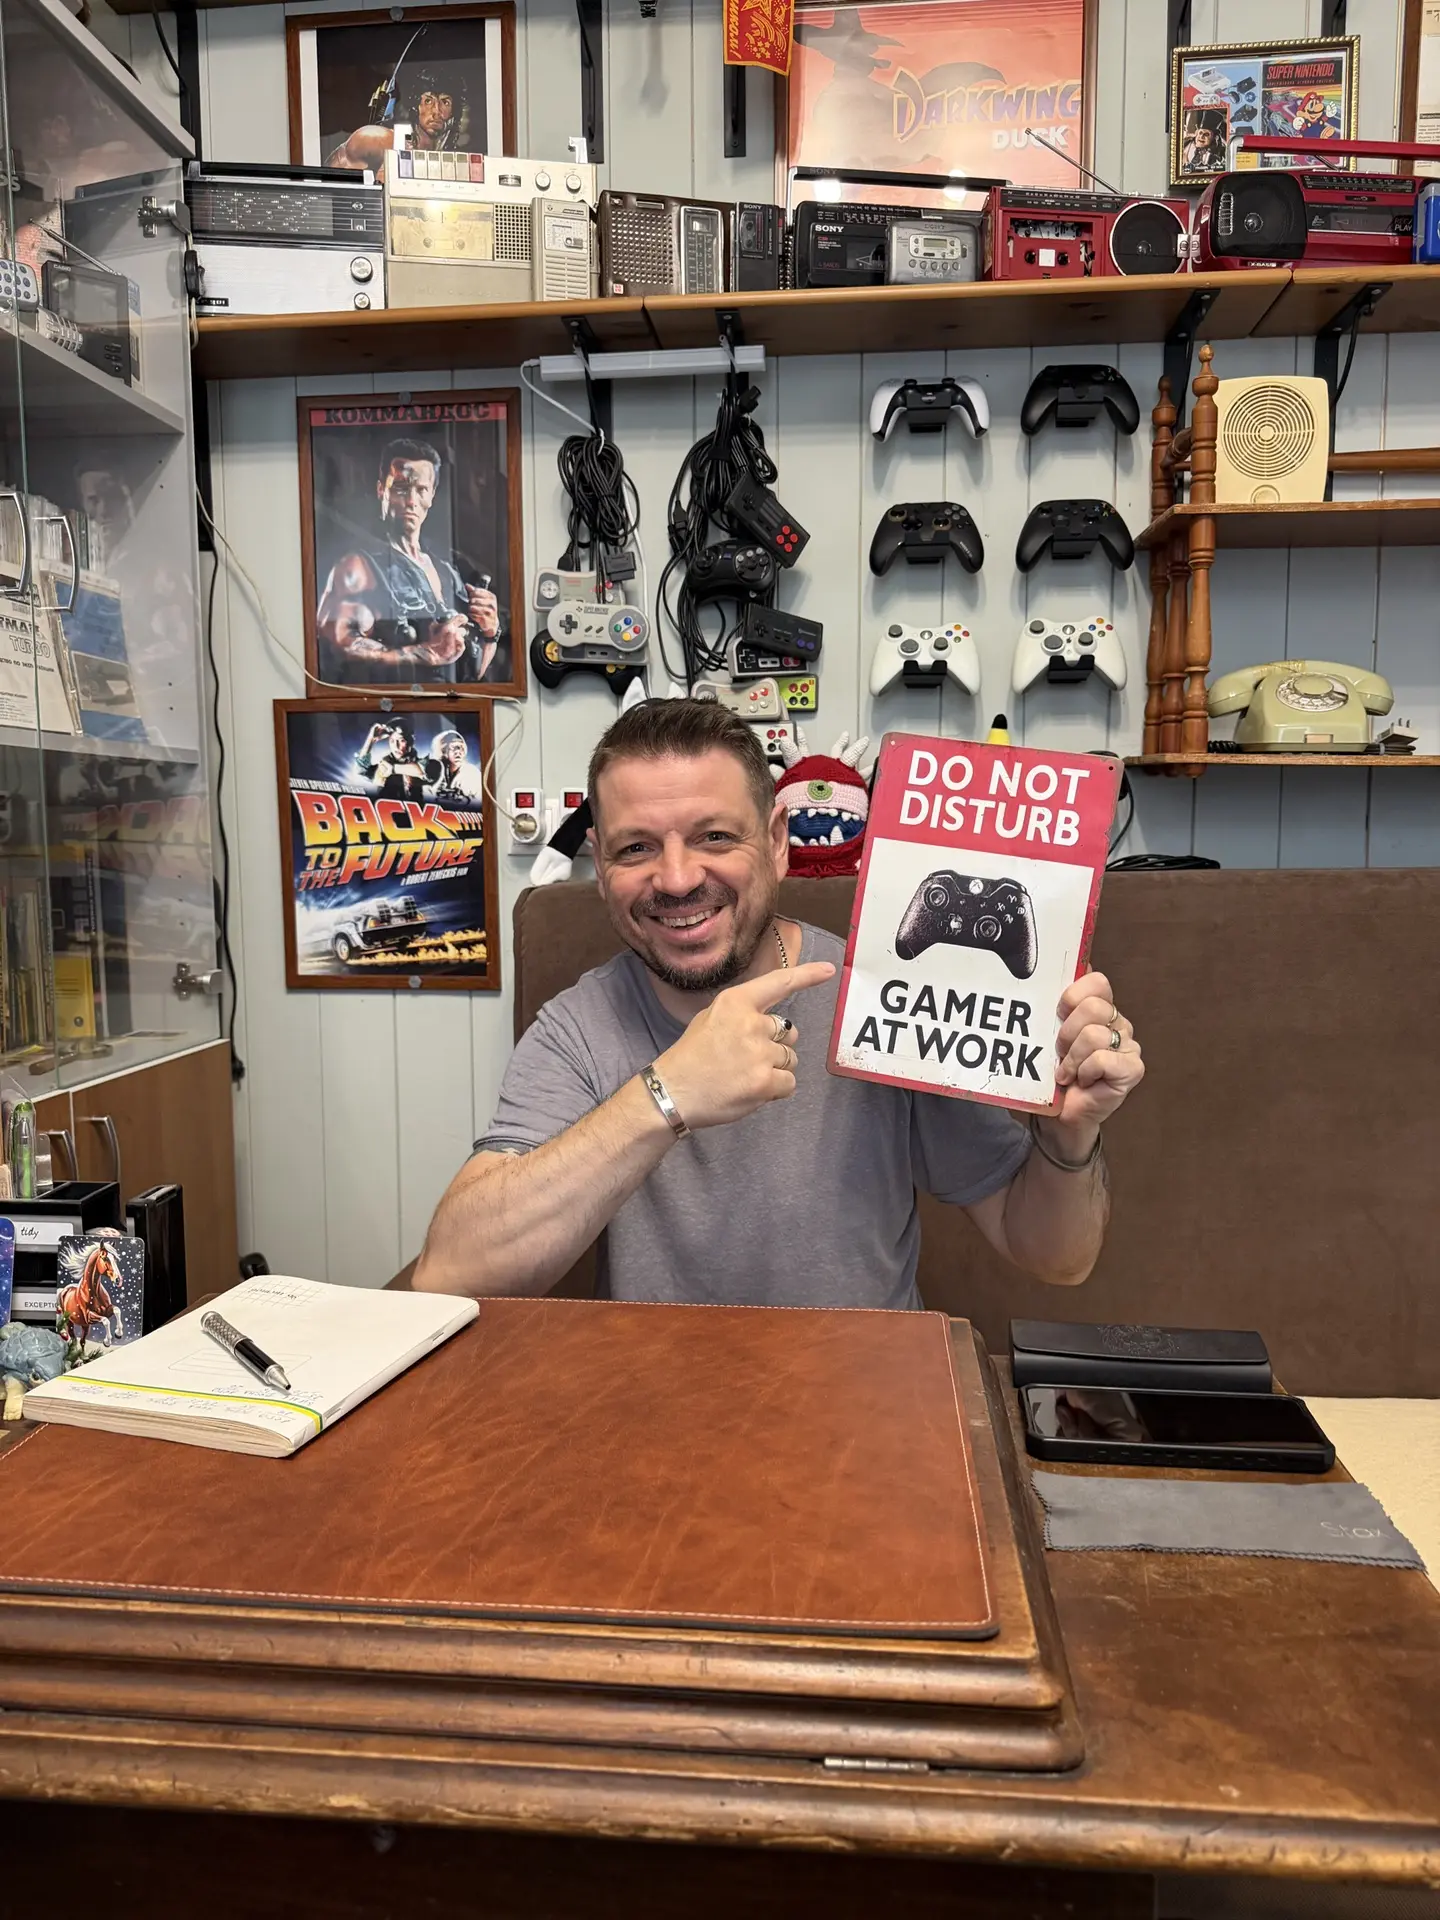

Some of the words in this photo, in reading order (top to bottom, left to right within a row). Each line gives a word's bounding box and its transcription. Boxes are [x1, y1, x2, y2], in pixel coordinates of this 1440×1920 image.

[1266, 64, 1295, 80] SUPER
[1294, 62, 1335, 78] NINTENDO
[891, 66, 1081, 144] DARKWING
[991, 125, 1070, 150] DUCK
[814, 224, 845, 233] SONY
[1394, 224, 1413, 232] PLAY
[907, 750, 973, 791] DO
[989, 759, 1090, 805] NOT
[292, 789, 459, 846] BACK
[899, 790, 1081, 847] DISTURB
[305, 847, 344, 868] TO
[339, 838, 483, 886] FUTURE
[299, 866, 341, 892] THE
[405, 872, 430, 886] ROBERT
[880, 980, 1032, 1037] GAMER
[852, 1016, 908, 1054] AT
[914, 1025, 1044, 1082] WORK
[20, 1226, 40, 1240] tidy
